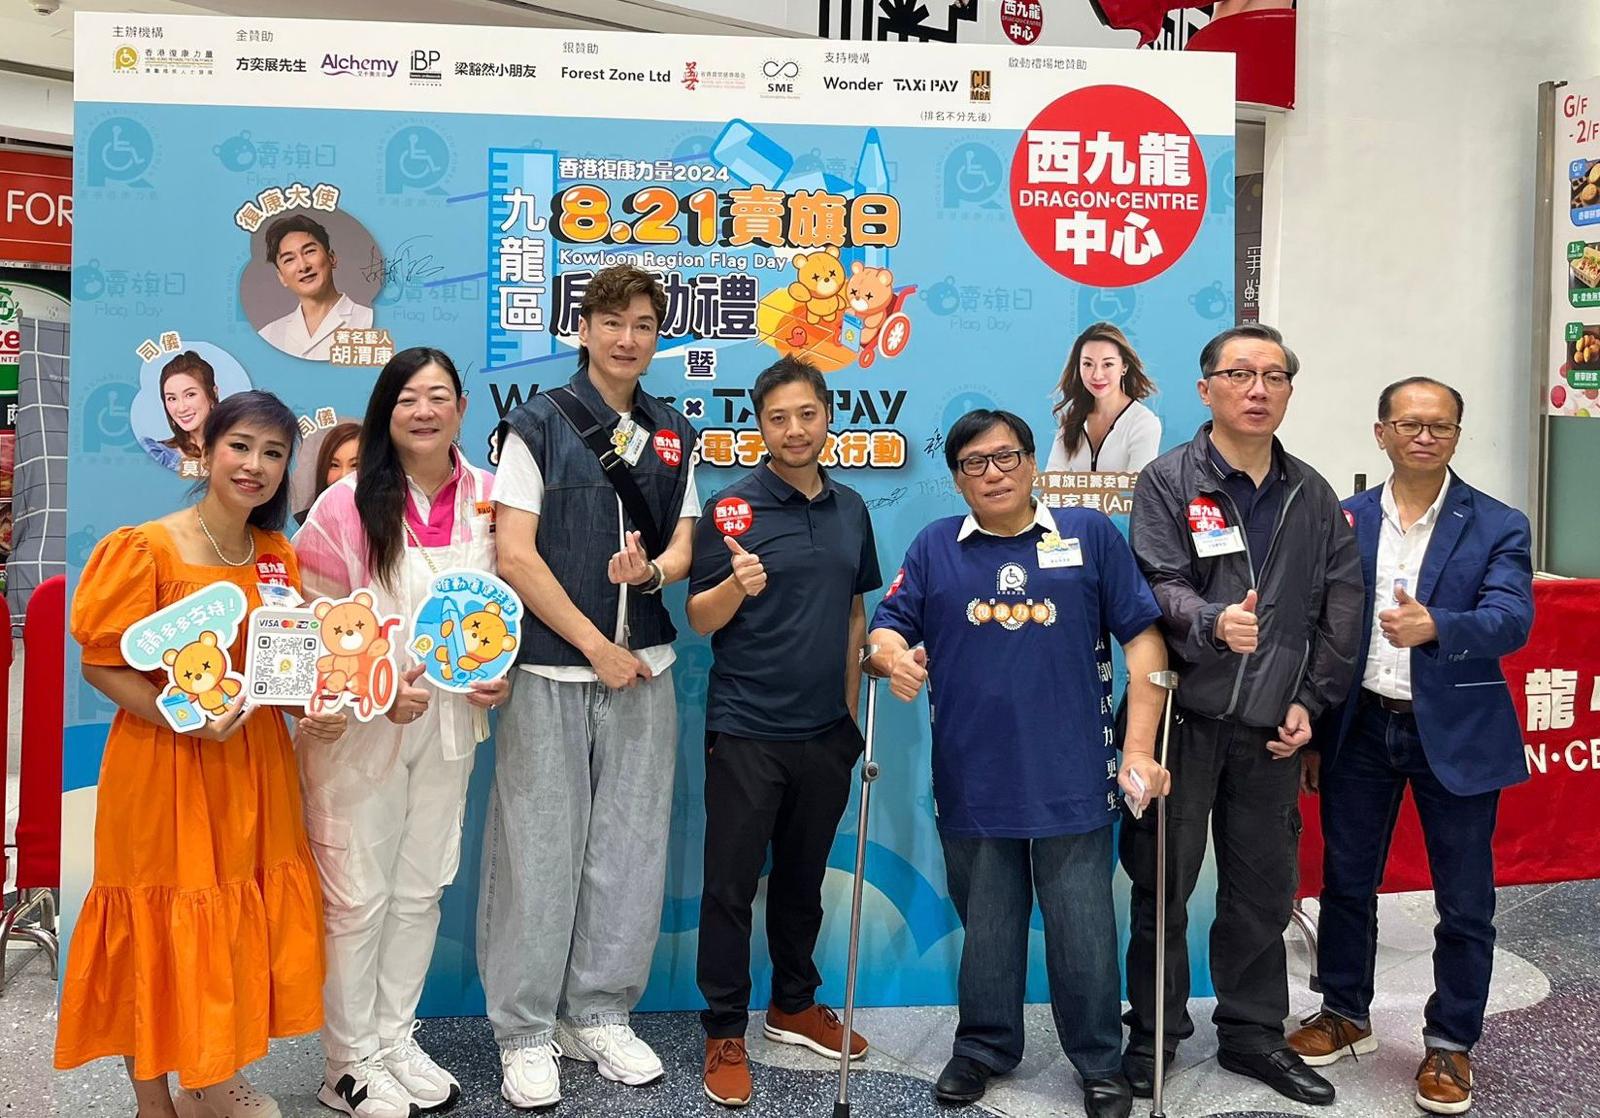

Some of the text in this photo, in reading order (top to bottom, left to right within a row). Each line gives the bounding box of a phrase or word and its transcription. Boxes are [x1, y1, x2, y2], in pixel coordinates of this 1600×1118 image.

[112, 25, 164, 39] 主辦機構
[236, 29, 274, 43] 金贊助
[1010, 23, 1034, 41] 中心
[236, 56, 308, 73] 方奕展先生
[320, 53, 399, 78] Alchemy
[824, 52, 871, 64] 支持機構
[454, 61, 537, 79] 梁豁然小朋友
[561, 66, 605, 80] Forest
[609, 68, 645, 82] Zone
[649, 70, 671, 83] Ltd
[767, 83, 794, 93] SME
[823, 76, 884, 91] Wonder
[930, 79, 959, 92] PAY
[970, 90, 991, 101] MBA
[1563, 95, 1588, 119] G/F
[1026, 129, 1192, 188] 西九龍
[558, 157, 730, 183] 香港復康力量2024
[235, 183, 341, 233] 復康大使
[1054, 210, 1164, 266] 中心
[499, 187, 546, 332] 九龍區
[559, 249, 788, 272] Kowloon Region Flag Day
[137, 331, 183, 363] 司儀
[687, 351, 716, 379] 暨
[181, 459, 208, 478] 莫
[723, 520, 746, 532] 中心
[136, 597, 236, 656] 請多多支持!
[259, 619, 279, 628] VISA
[1525, 668, 1600, 732] 龍
